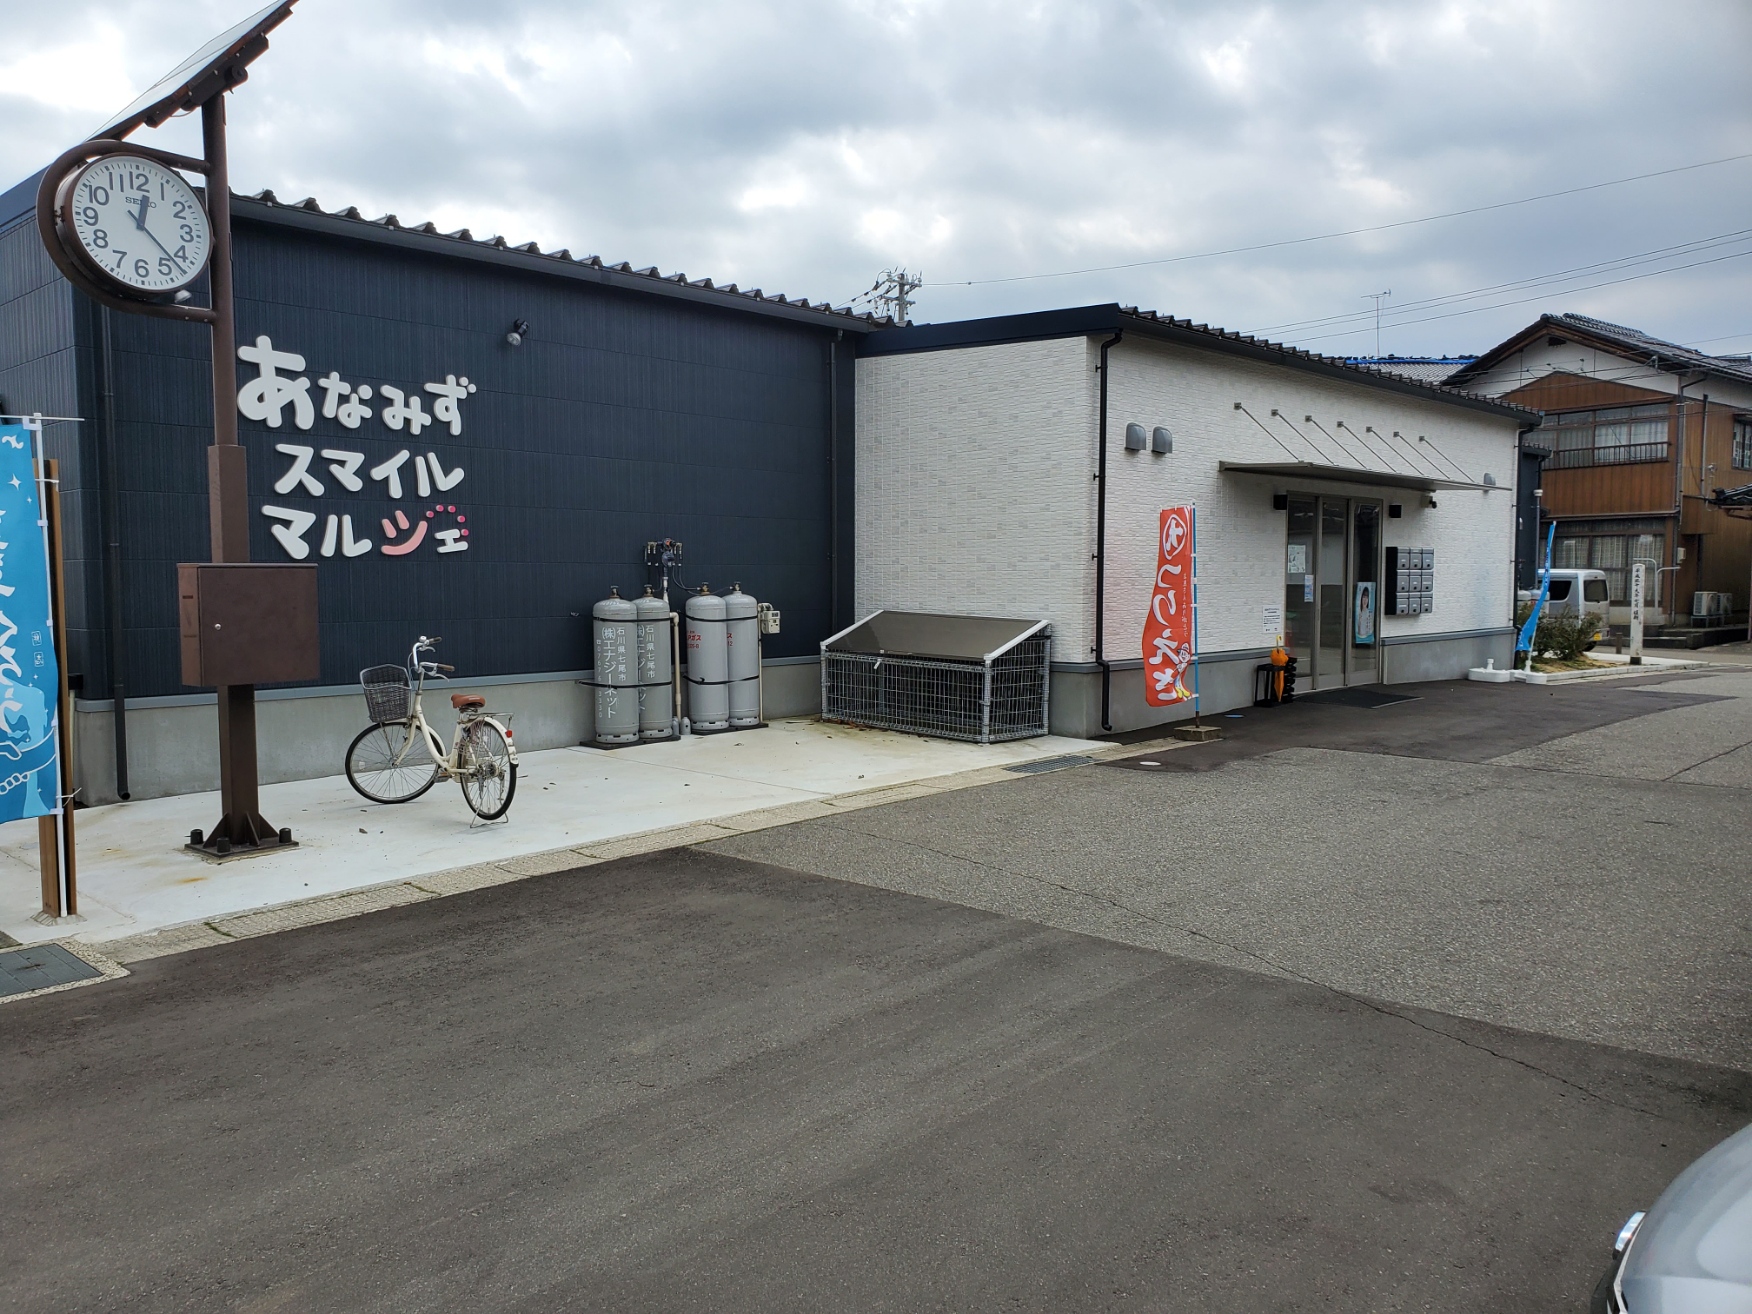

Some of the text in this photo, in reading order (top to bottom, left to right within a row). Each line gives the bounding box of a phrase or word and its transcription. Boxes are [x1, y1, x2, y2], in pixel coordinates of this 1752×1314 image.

[109, 172, 124, 192] 11
[130, 171, 150, 193] 12
[160, 182, 165, 201] 1
[88, 184, 110, 206] 10
[82, 206, 98, 226] 9
[172, 200, 187, 220] 2
[92, 228, 109, 249] 8
[179, 224, 194, 244] 3
[112, 250, 128, 269] 7
[174, 244, 189, 263] 4
[134, 258, 150, 278] 6
[158, 257, 172, 276] 5
[237, 335, 477, 436] あなみず
[274, 443, 465, 499] スマイル
[616, 627, 626, 681] 石川県七尾市
